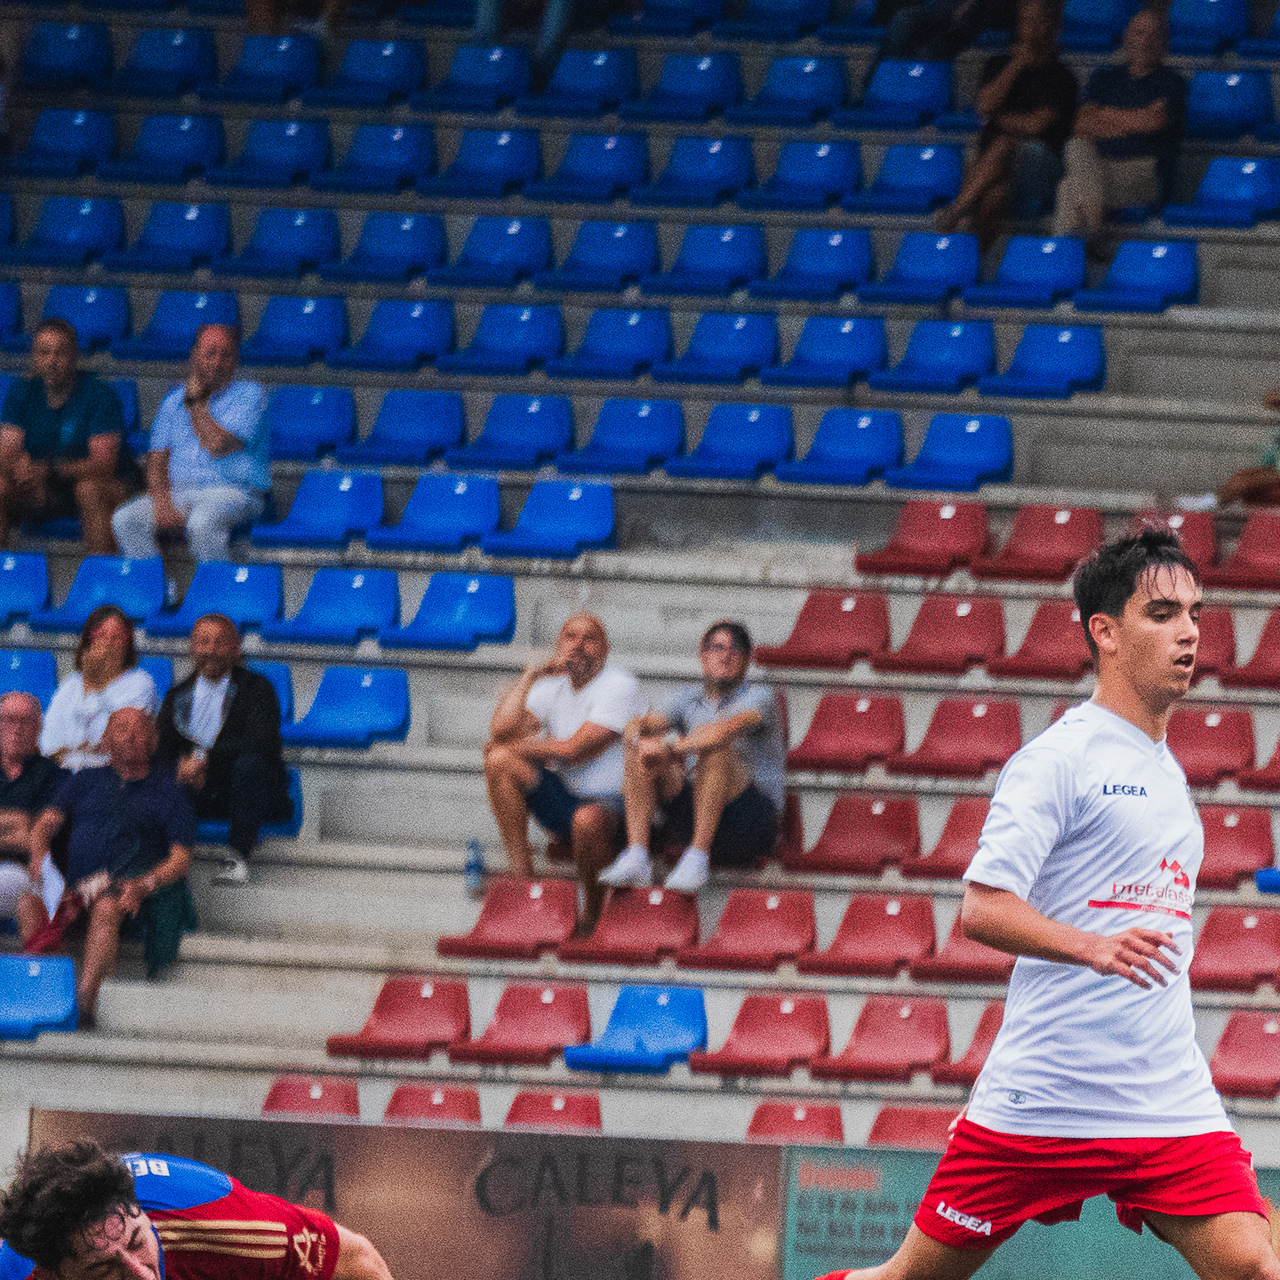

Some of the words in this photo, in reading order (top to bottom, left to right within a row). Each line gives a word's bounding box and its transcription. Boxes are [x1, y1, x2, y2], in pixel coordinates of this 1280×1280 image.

[1102, 784, 1148, 798] LEGEA
[475, 1150, 721, 1232] CALEYA
[936, 1200, 992, 1236] LEGEA
